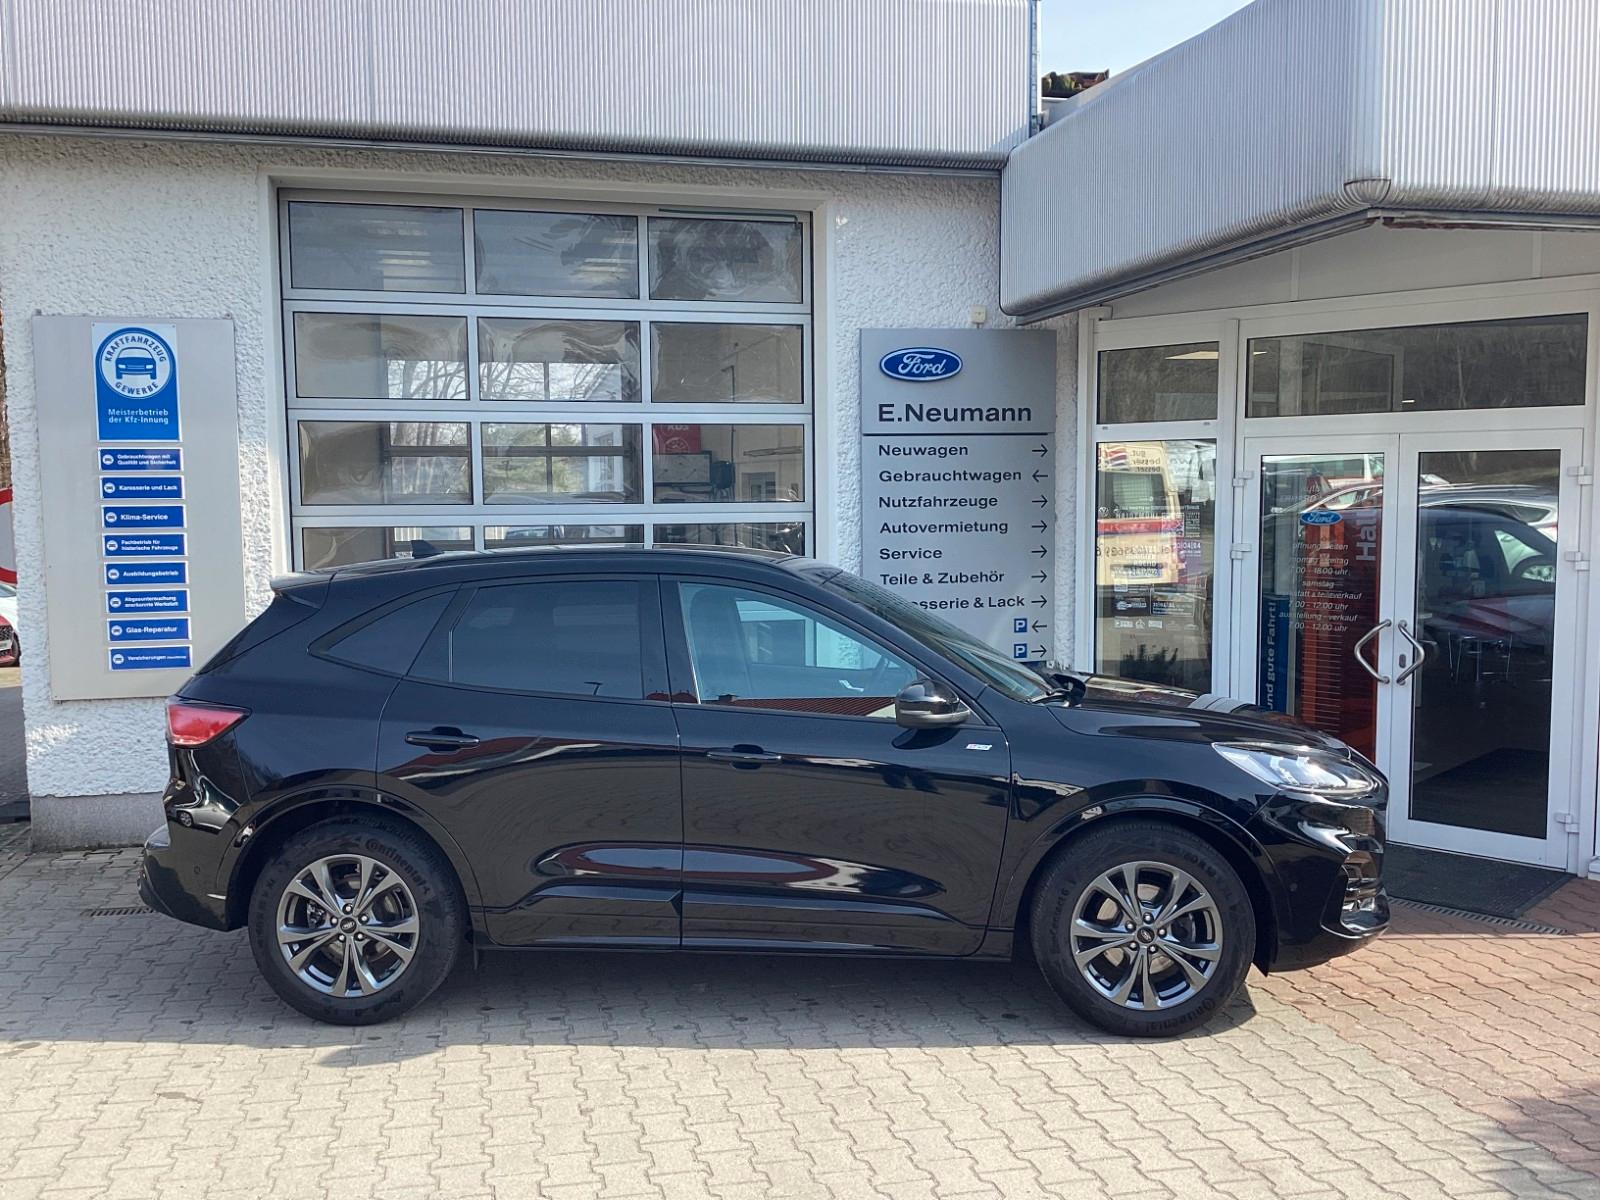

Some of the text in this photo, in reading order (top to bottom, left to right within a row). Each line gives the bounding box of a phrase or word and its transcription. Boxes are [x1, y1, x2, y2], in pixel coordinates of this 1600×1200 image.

[104, 335, 167, 362] KRAFTFAHRZEUG
[897, 352, 947, 375] Ford
[115, 381, 159, 395] GEWERBE
[108, 408, 169, 416] Meisterbetrieb
[878, 403, 1032, 423] E.Neumann
[108, 416, 169, 425] der Kfz-Innung
[878, 444, 969, 459] Neuwagen
[878, 469, 1022, 484] Gebrauchtwagen
[878, 495, 998, 510] Nutzfahrzeuge
[120, 513, 169, 521] Klima-Service
[879, 521, 1009, 535] Autovermietung
[879, 547, 943, 561] Service
[880, 570, 1005, 585] Teile & Zubehör
[911, 595, 1025, 610] sserie & Lack
[125, 626, 178, 634] Glas-Reparatur
[1266, 647, 1276, 682] gute
